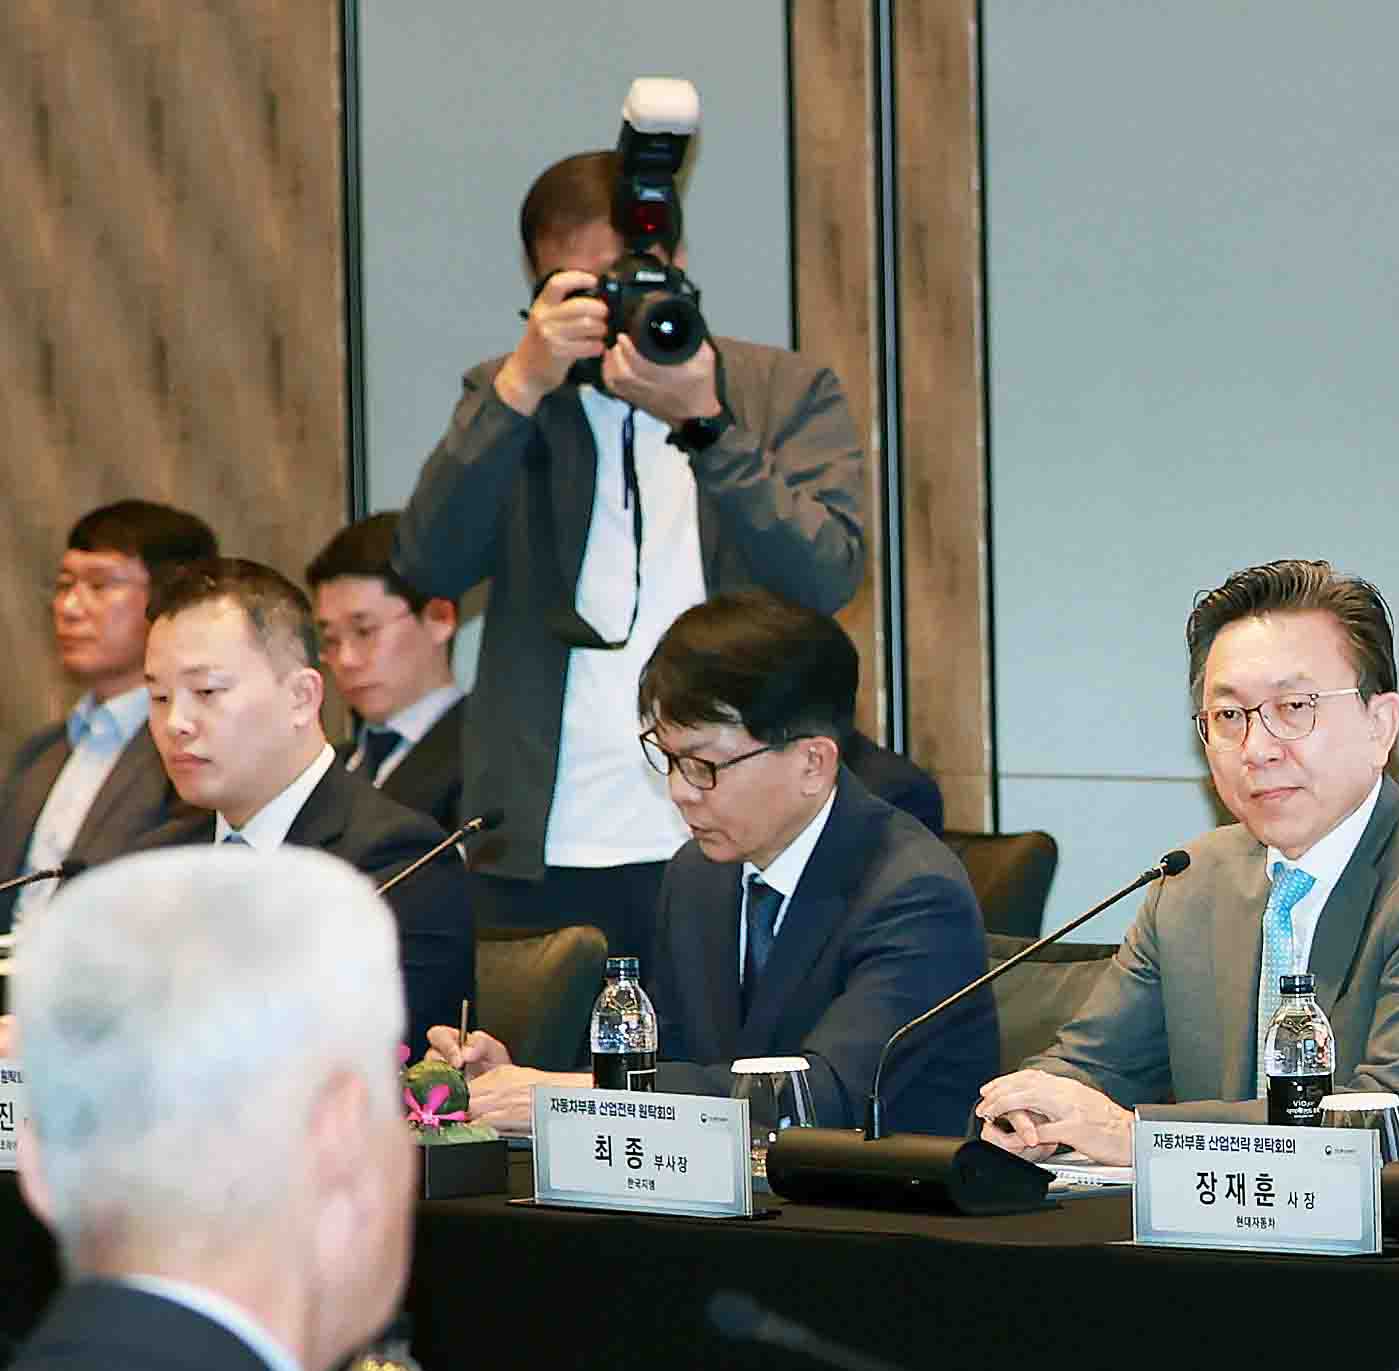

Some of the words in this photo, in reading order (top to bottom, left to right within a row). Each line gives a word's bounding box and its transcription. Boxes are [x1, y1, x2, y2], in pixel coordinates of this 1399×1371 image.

[550, 1098, 597, 1115] 자동차부품
[599, 1102, 636, 1118] 산업전략
[638, 1103, 676, 1120] 원탁회의
[1153, 1132, 1206, 1150] 자동차부품
[1208, 1135, 1251, 1152] 산업전략
[1253, 1136, 1296, 1154] 원탁회의
[653, 1154, 689, 1174] 부사장
[1195, 1170, 1275, 1207] 장재훈
[1286, 1190, 1315, 1210] 사장
[1235, 1215, 1276, 1230] 현대자동차
